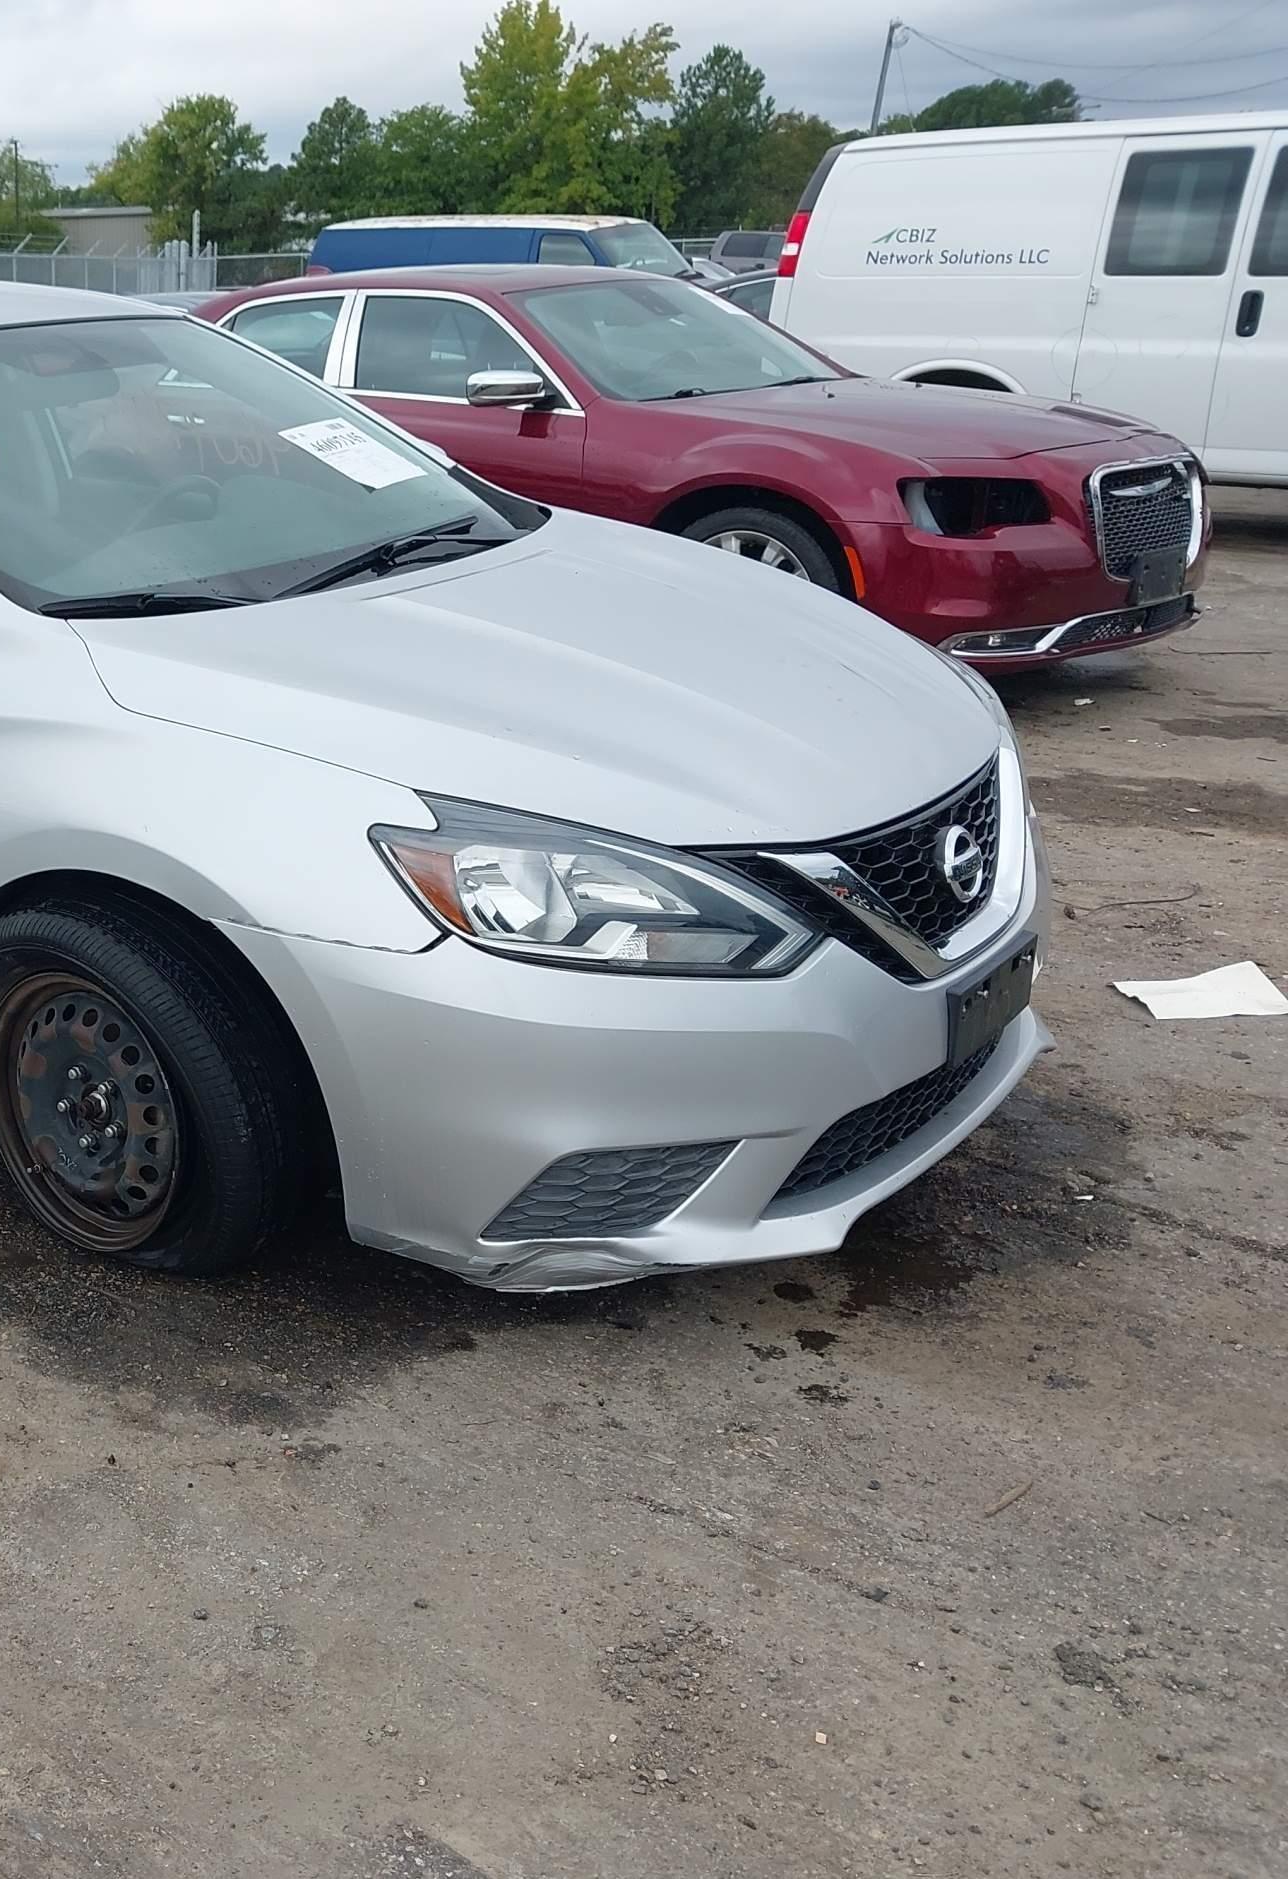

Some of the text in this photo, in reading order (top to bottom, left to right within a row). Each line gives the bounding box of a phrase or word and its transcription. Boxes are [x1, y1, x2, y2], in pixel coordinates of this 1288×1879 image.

[896, 228, 937, 243] CBIZ
[866, 249, 1050, 265] Network Solutions LLC
